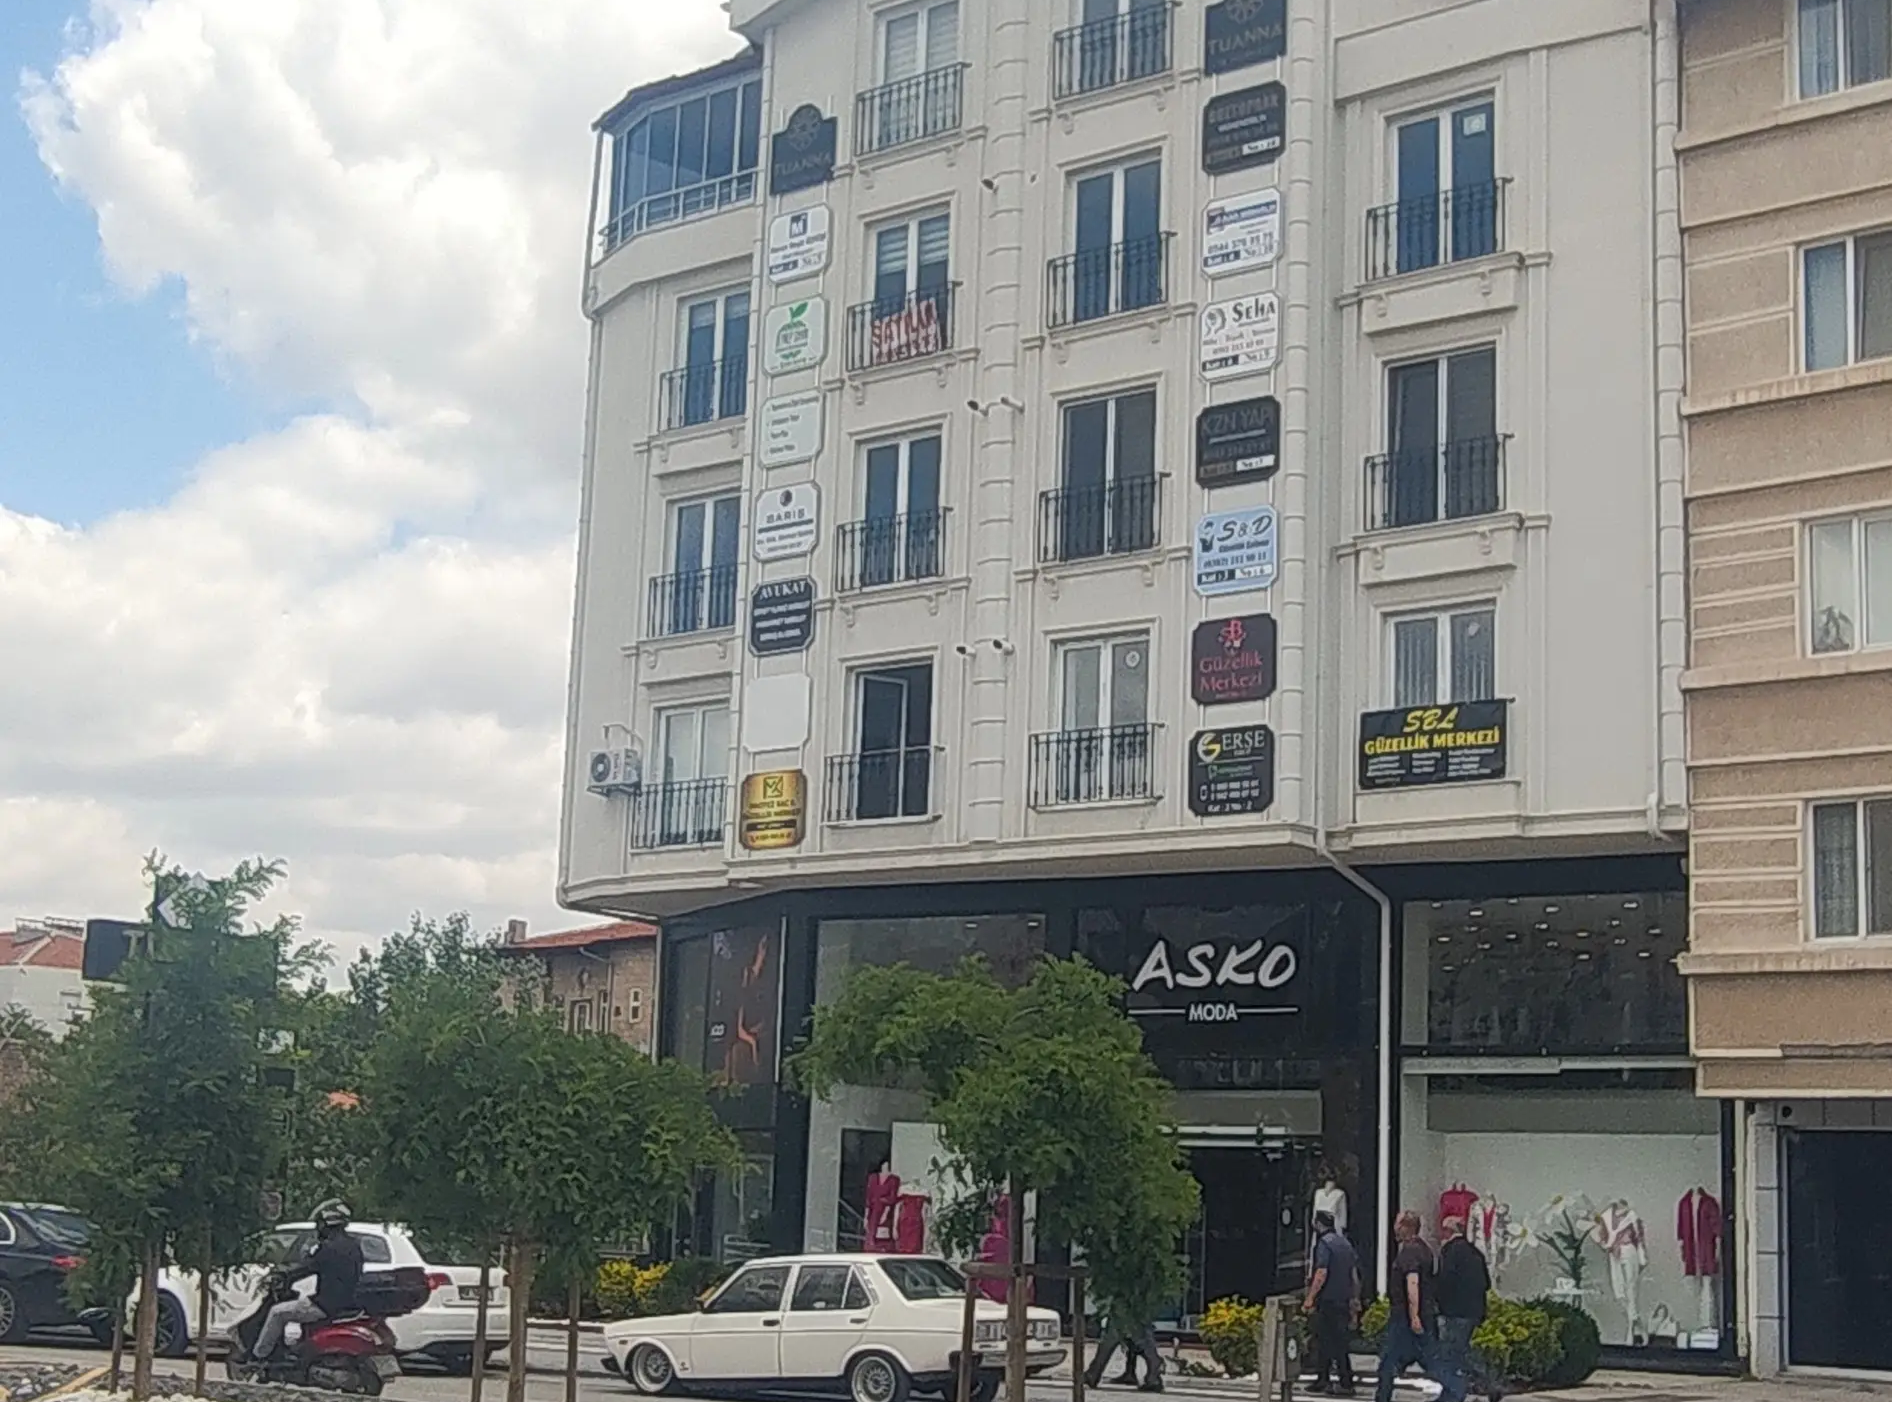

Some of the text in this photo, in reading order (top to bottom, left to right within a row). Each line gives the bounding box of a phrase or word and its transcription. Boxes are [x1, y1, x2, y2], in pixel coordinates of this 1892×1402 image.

[1208, 21, 1284, 56] TUANNA
[1199, 649, 1264, 673] Güzellik
[1200, 672, 1263, 693] Merkezi
[1403, 706, 1460, 733] SBL
[1364, 725, 1500, 755] GÜZELLİK MERKEZİ
[1132, 939, 1297, 991] ASKO
[1188, 1002, 1238, 1022] MODA
